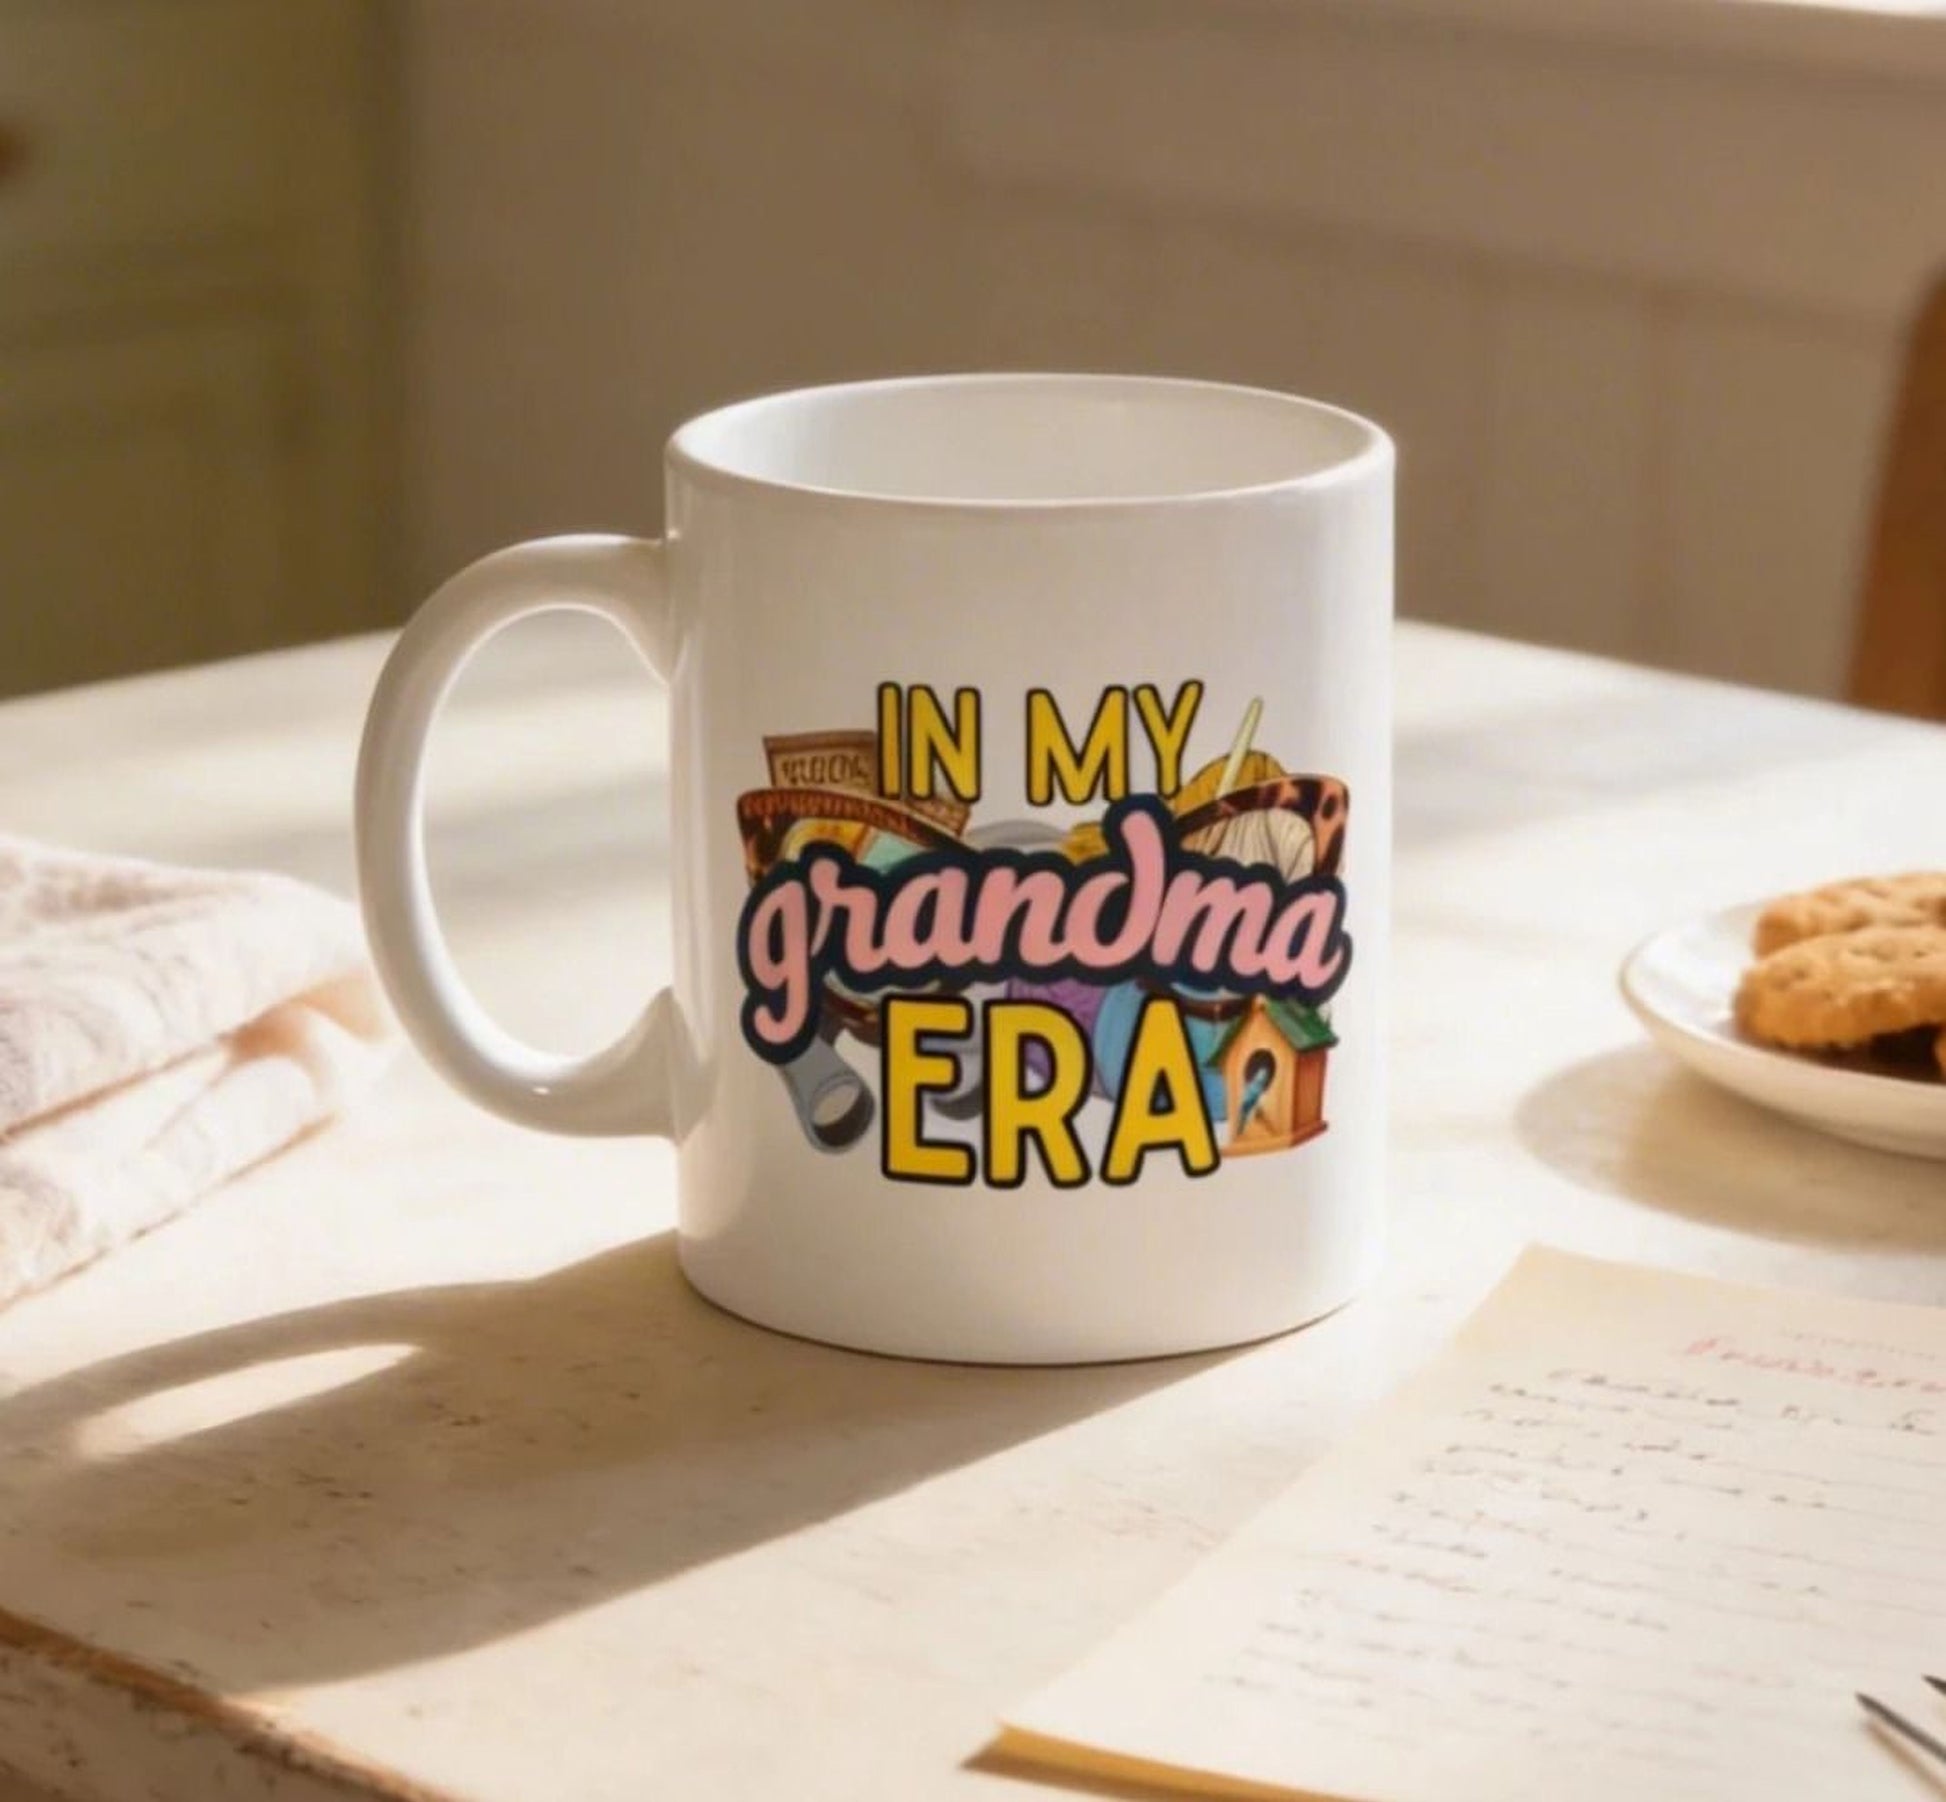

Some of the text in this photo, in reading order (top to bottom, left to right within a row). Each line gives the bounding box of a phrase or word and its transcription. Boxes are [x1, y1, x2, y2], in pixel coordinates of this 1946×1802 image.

[877, 680, 1204, 806] IN MY
[741, 800, 1350, 1058] grandma
[881, 994, 1220, 1188] ERA
